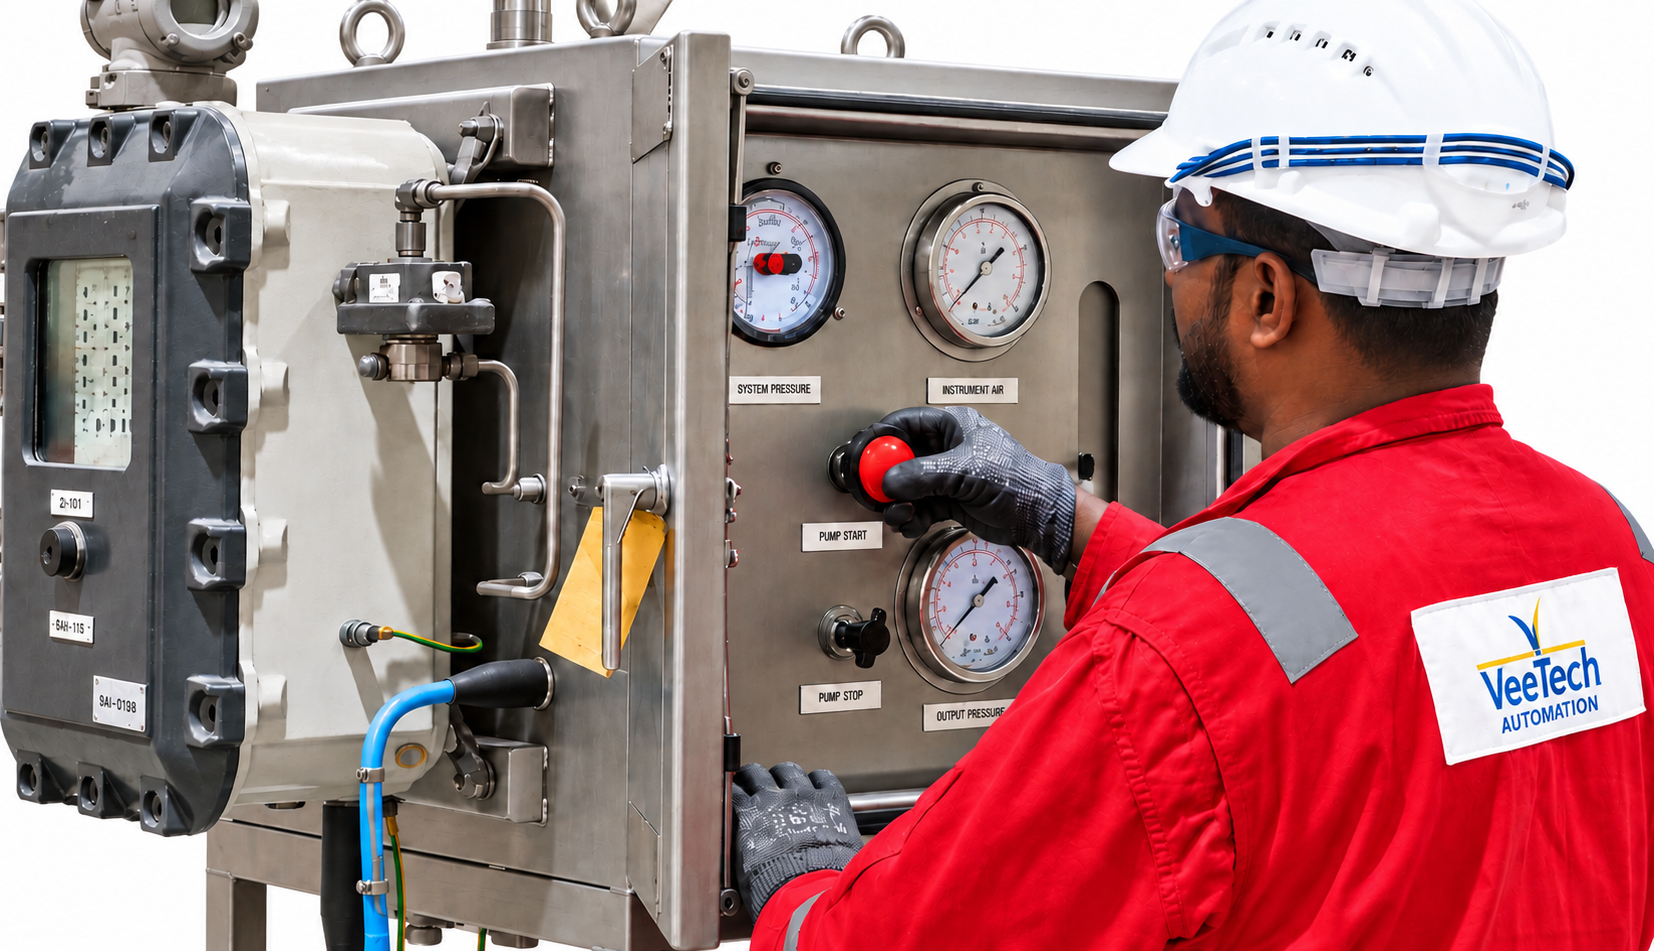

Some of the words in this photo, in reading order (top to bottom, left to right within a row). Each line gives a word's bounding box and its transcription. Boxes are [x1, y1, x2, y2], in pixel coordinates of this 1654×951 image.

[737, 383, 769, 395] SYSTEM
[771, 383, 811, 394] PRESSURE
[942, 385, 990, 395] INSTRUMENT
[991, 385, 1004, 395] AIR
[819, 531, 842, 542] PUMP
[843, 529, 868, 541] START
[1479, 646, 1602, 711] VeeTech
[818, 692, 841, 703] PUMP
[843, 689, 864, 701] STOP
[936, 709, 966, 722] OUTPUT
[1501, 694, 1599, 735] AUTOMATION
